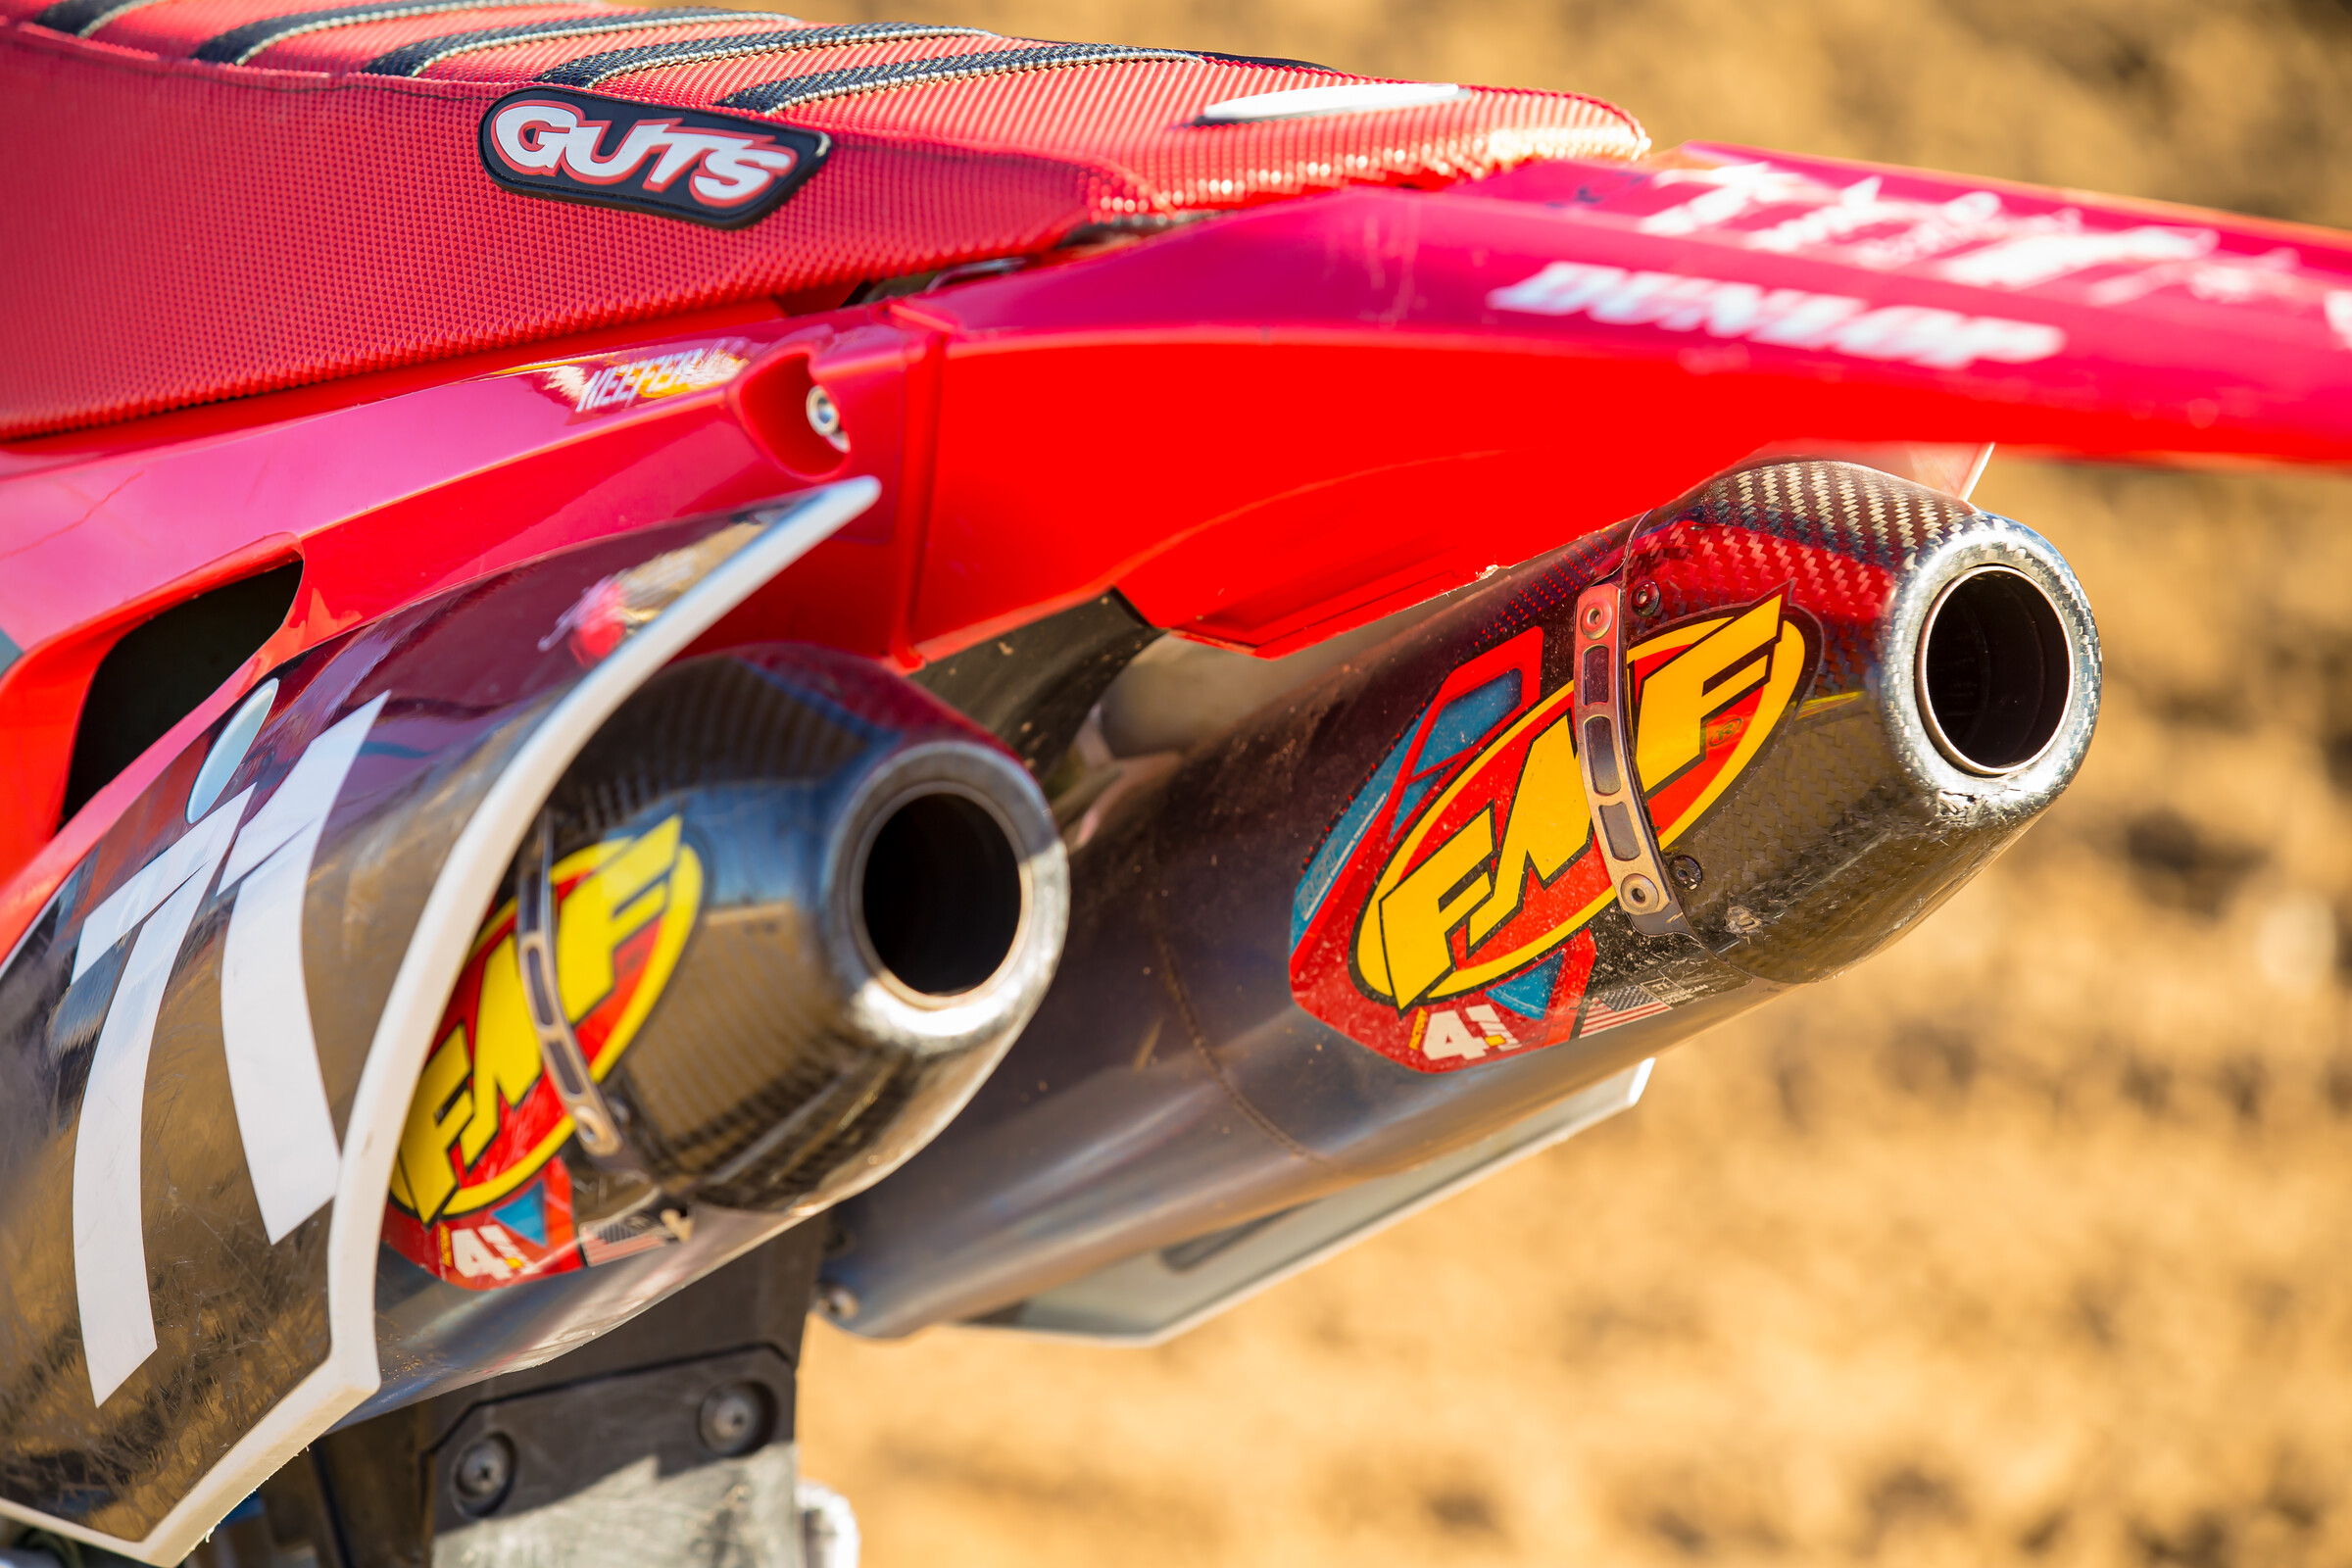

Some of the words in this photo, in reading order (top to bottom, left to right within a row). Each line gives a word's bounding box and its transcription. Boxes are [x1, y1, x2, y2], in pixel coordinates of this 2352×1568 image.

[492, 102, 796, 207] GUTS
[1380, 592, 1784, 1013] FMF
[395, 814, 683, 1229] FMF
